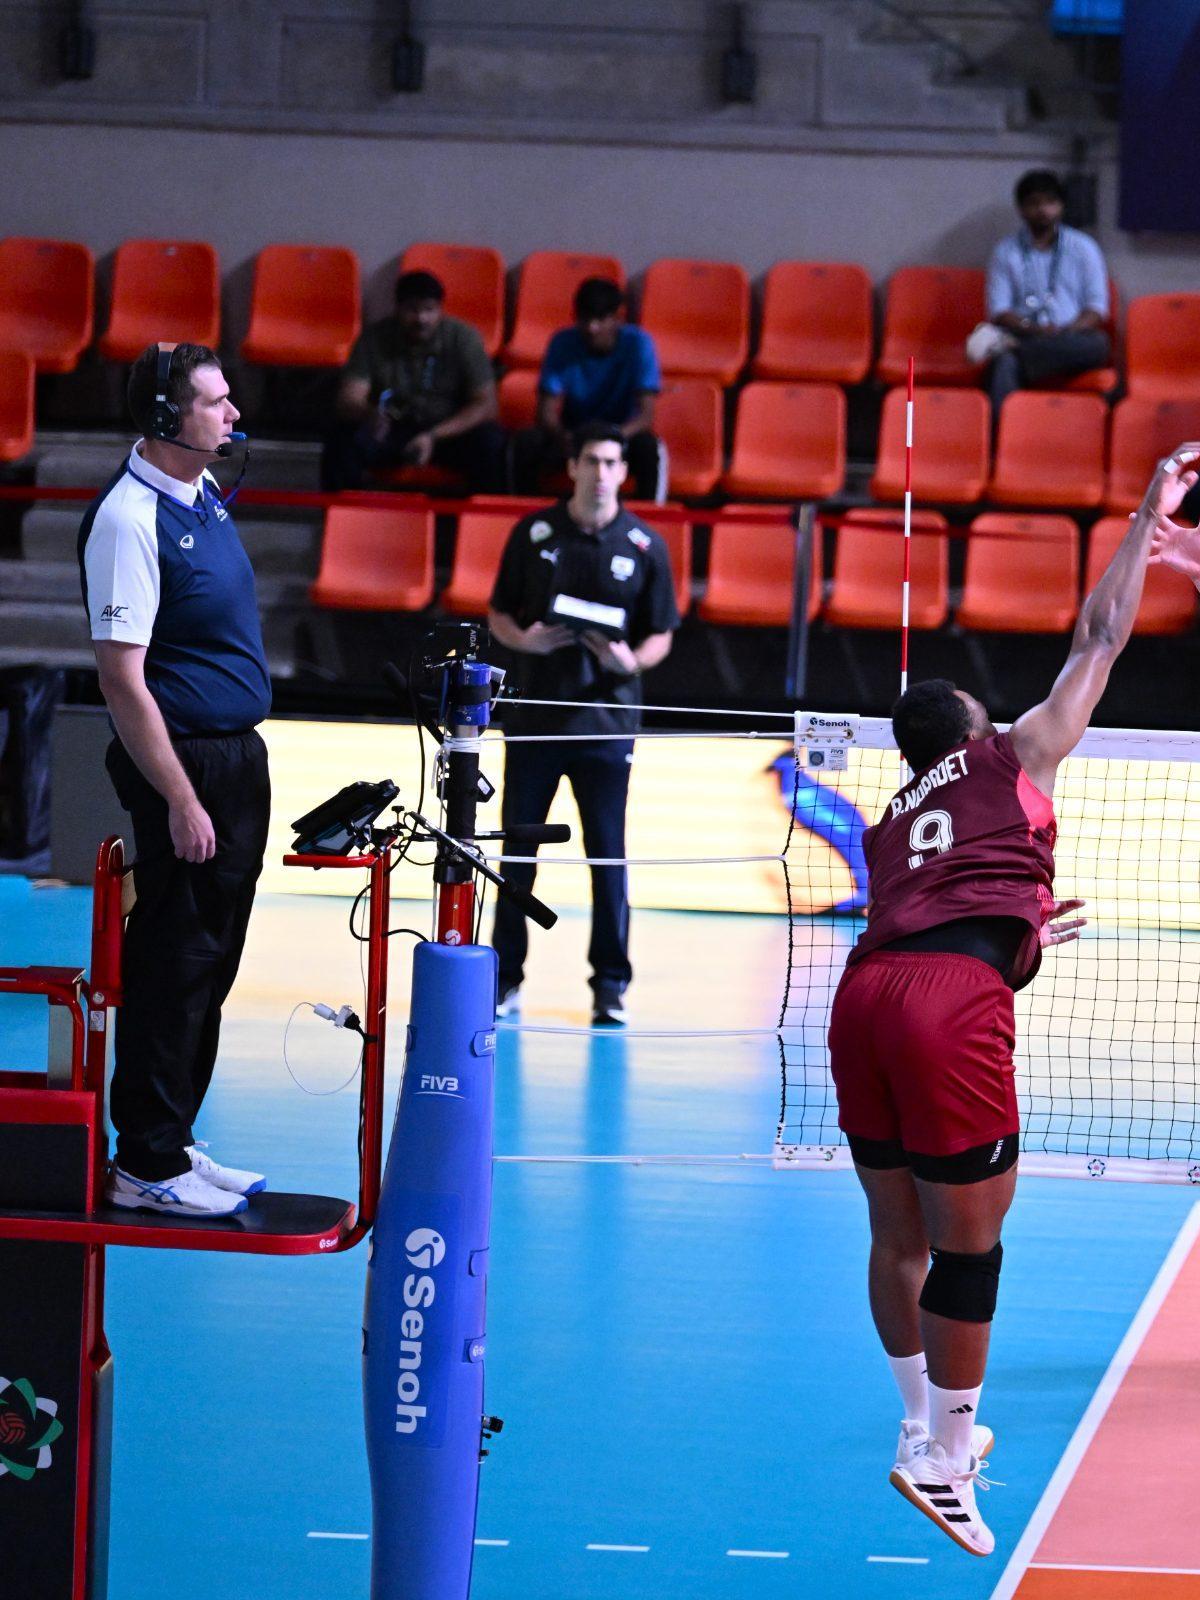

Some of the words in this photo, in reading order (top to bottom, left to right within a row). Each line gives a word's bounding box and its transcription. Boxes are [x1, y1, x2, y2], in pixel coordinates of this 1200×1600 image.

[100, 605, 128, 618] AVC
[818, 719, 850, 727] Senoh
[908, 809, 954, 870] 9
[420, 1074, 459, 1092] FIVB
[395, 1273, 436, 1434] Senoh
